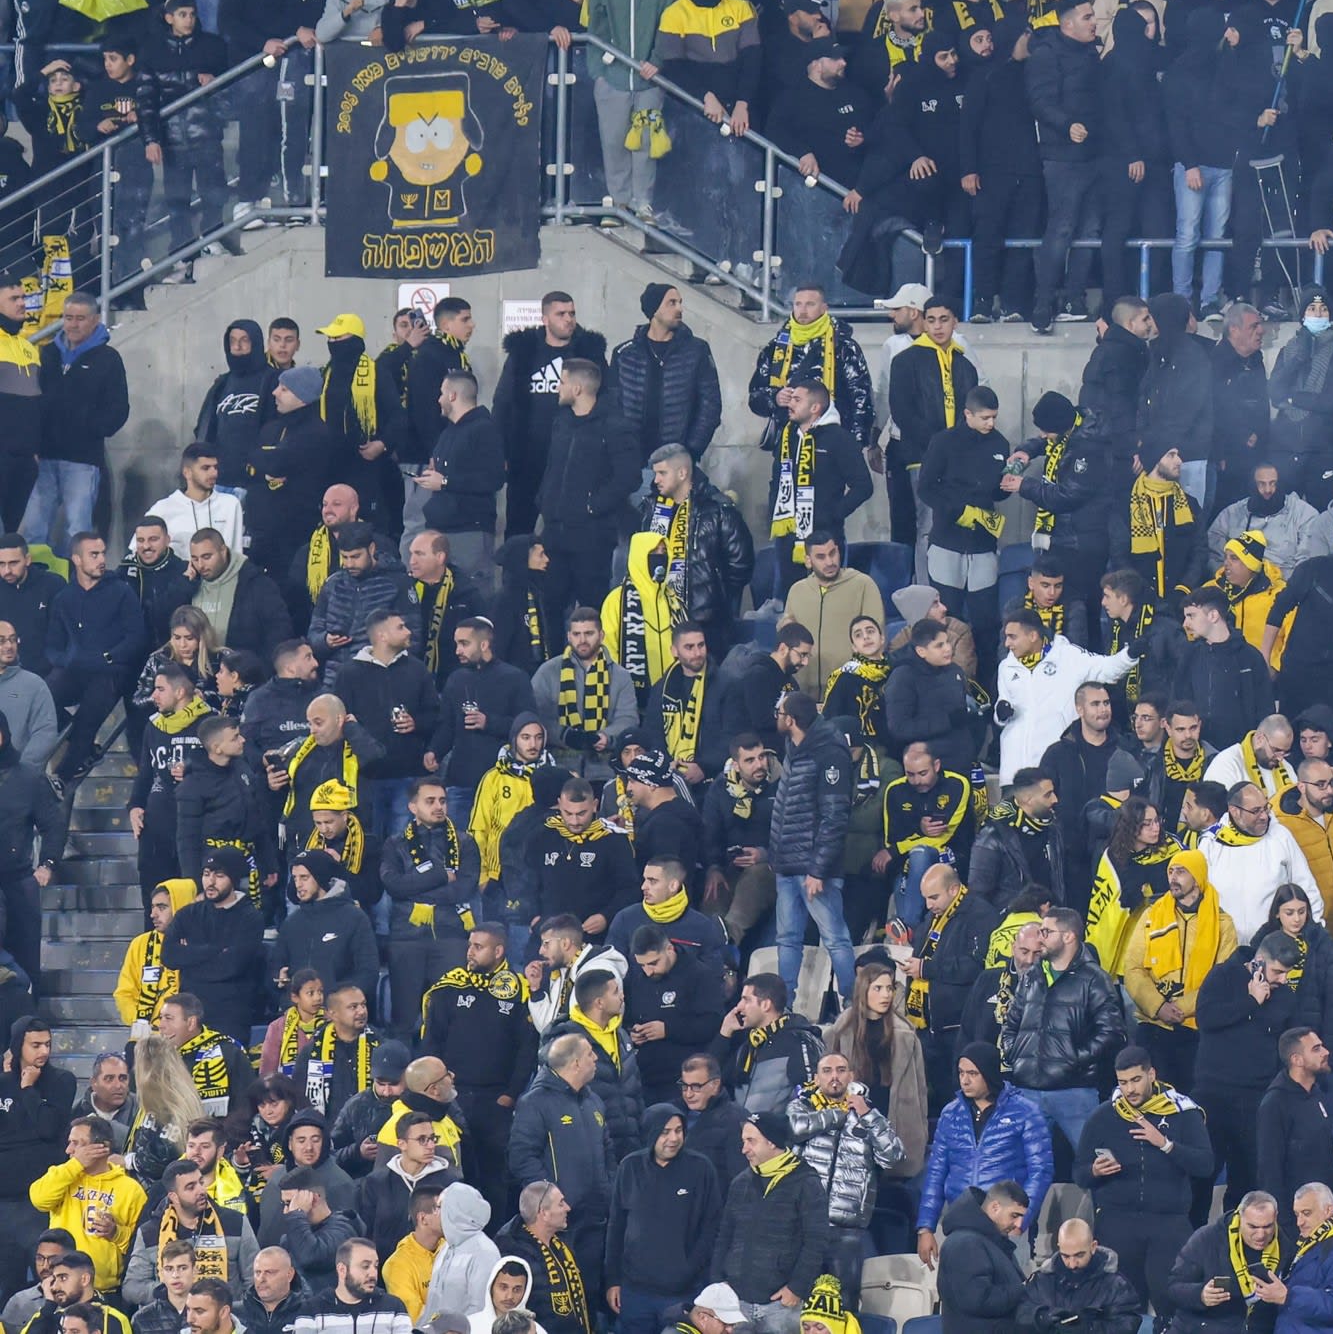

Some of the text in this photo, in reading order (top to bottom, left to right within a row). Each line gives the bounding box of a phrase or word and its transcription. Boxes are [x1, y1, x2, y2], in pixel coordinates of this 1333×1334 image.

[336, 91, 359, 134] 2005
[361, 228, 496, 270] המשפחה
[502, 785, 512, 799] 8
